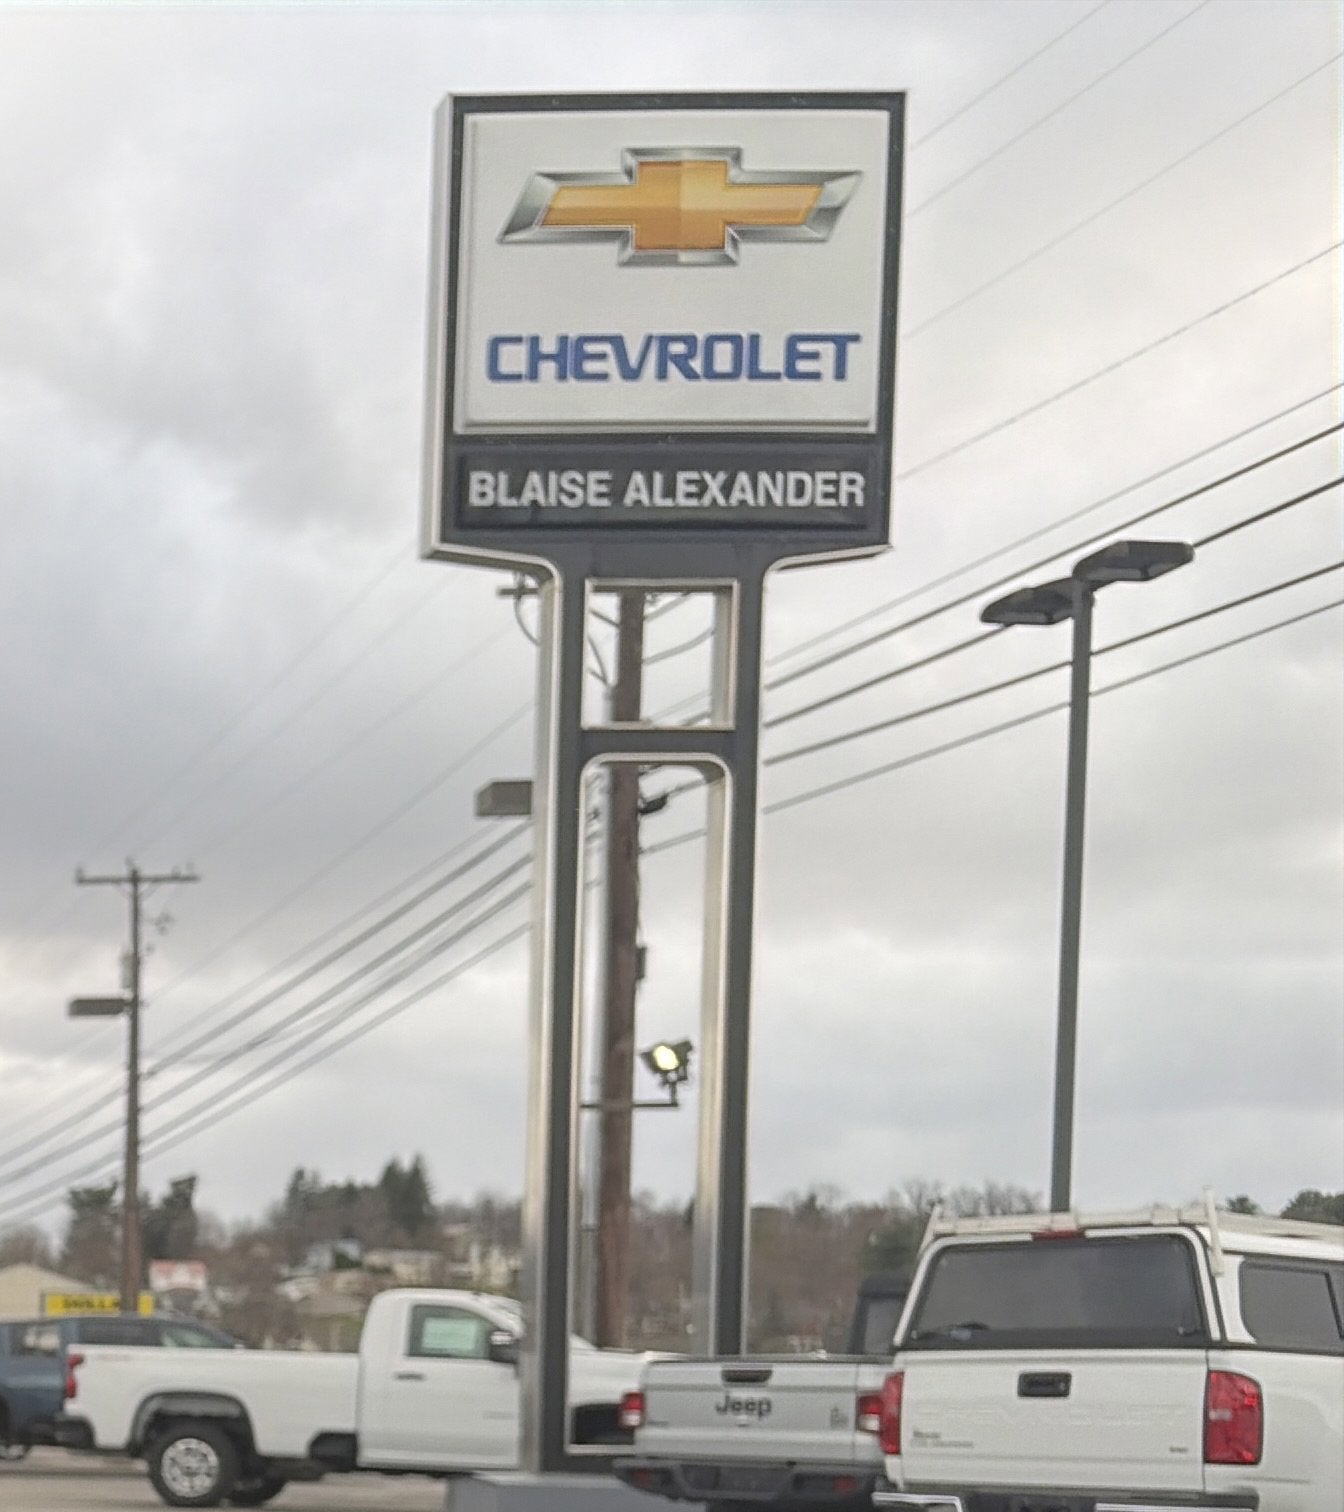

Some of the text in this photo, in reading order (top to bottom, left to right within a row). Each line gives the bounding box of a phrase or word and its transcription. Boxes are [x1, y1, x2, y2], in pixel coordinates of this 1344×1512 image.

[486, 332, 862, 382] CHEVROLET
[468, 470, 866, 508] BLAISE ALEXANDER
[715, 1392, 772, 1420] Jeep
